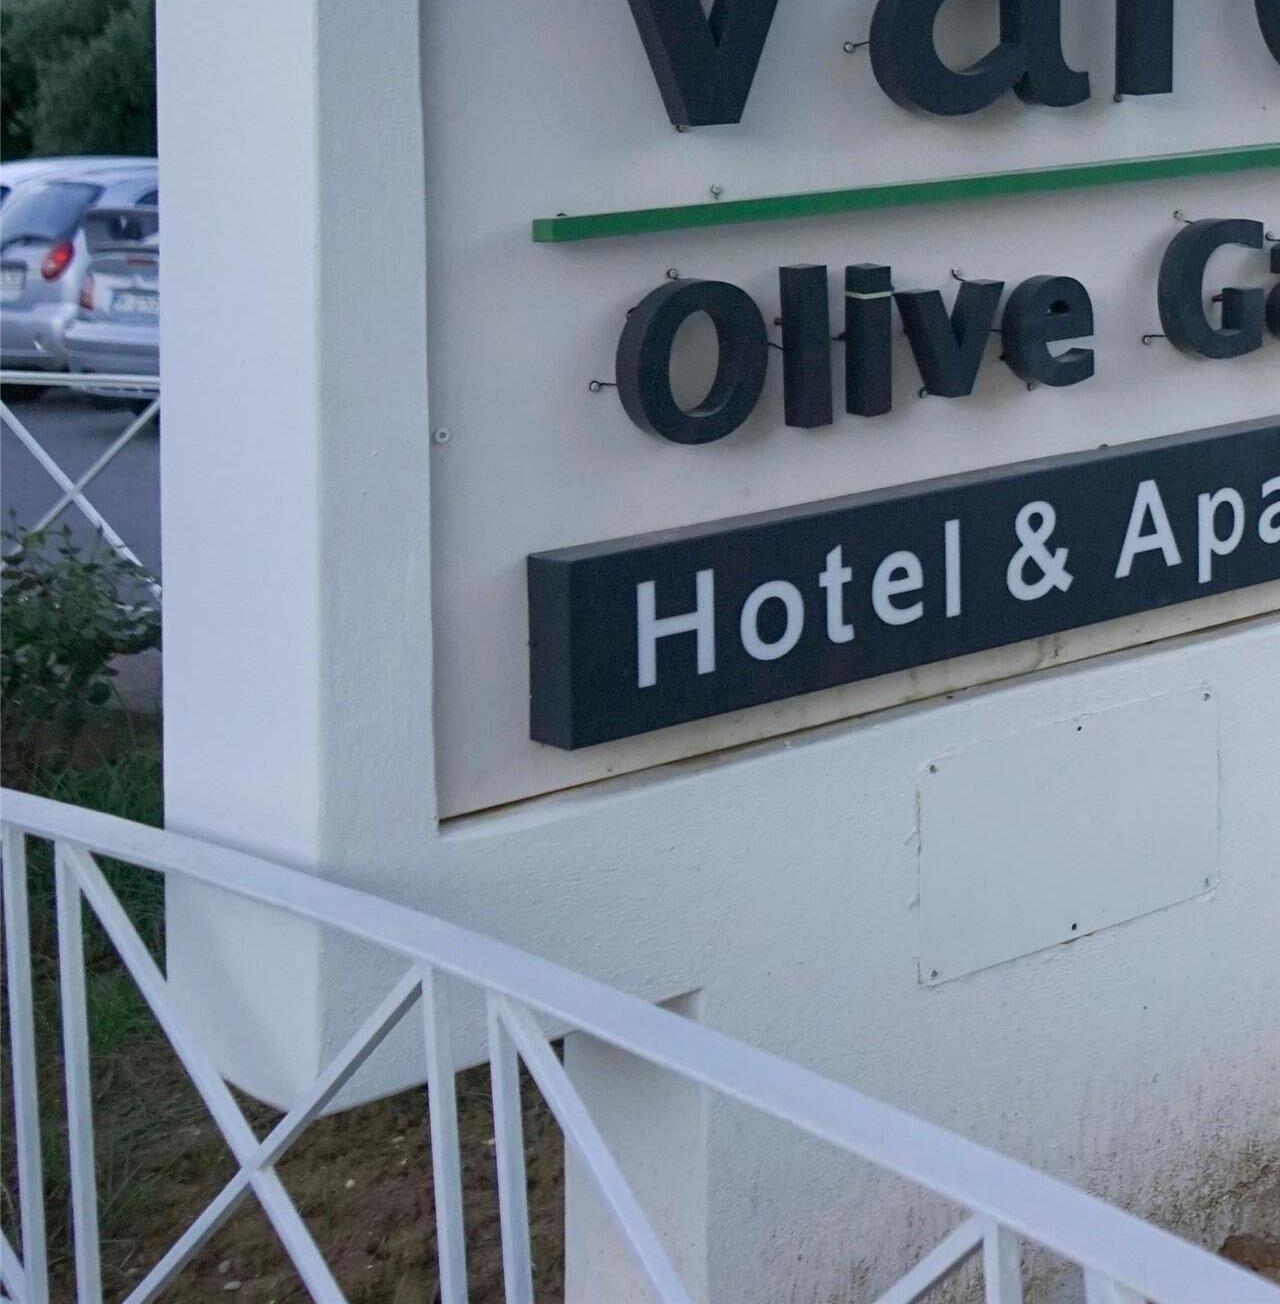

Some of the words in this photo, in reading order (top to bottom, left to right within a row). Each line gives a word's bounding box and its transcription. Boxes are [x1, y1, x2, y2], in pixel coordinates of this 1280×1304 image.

[615, 262, 1094, 444] Olive
[636, 520, 960, 688] Hotel
[1006, 501, 1072, 601] &
